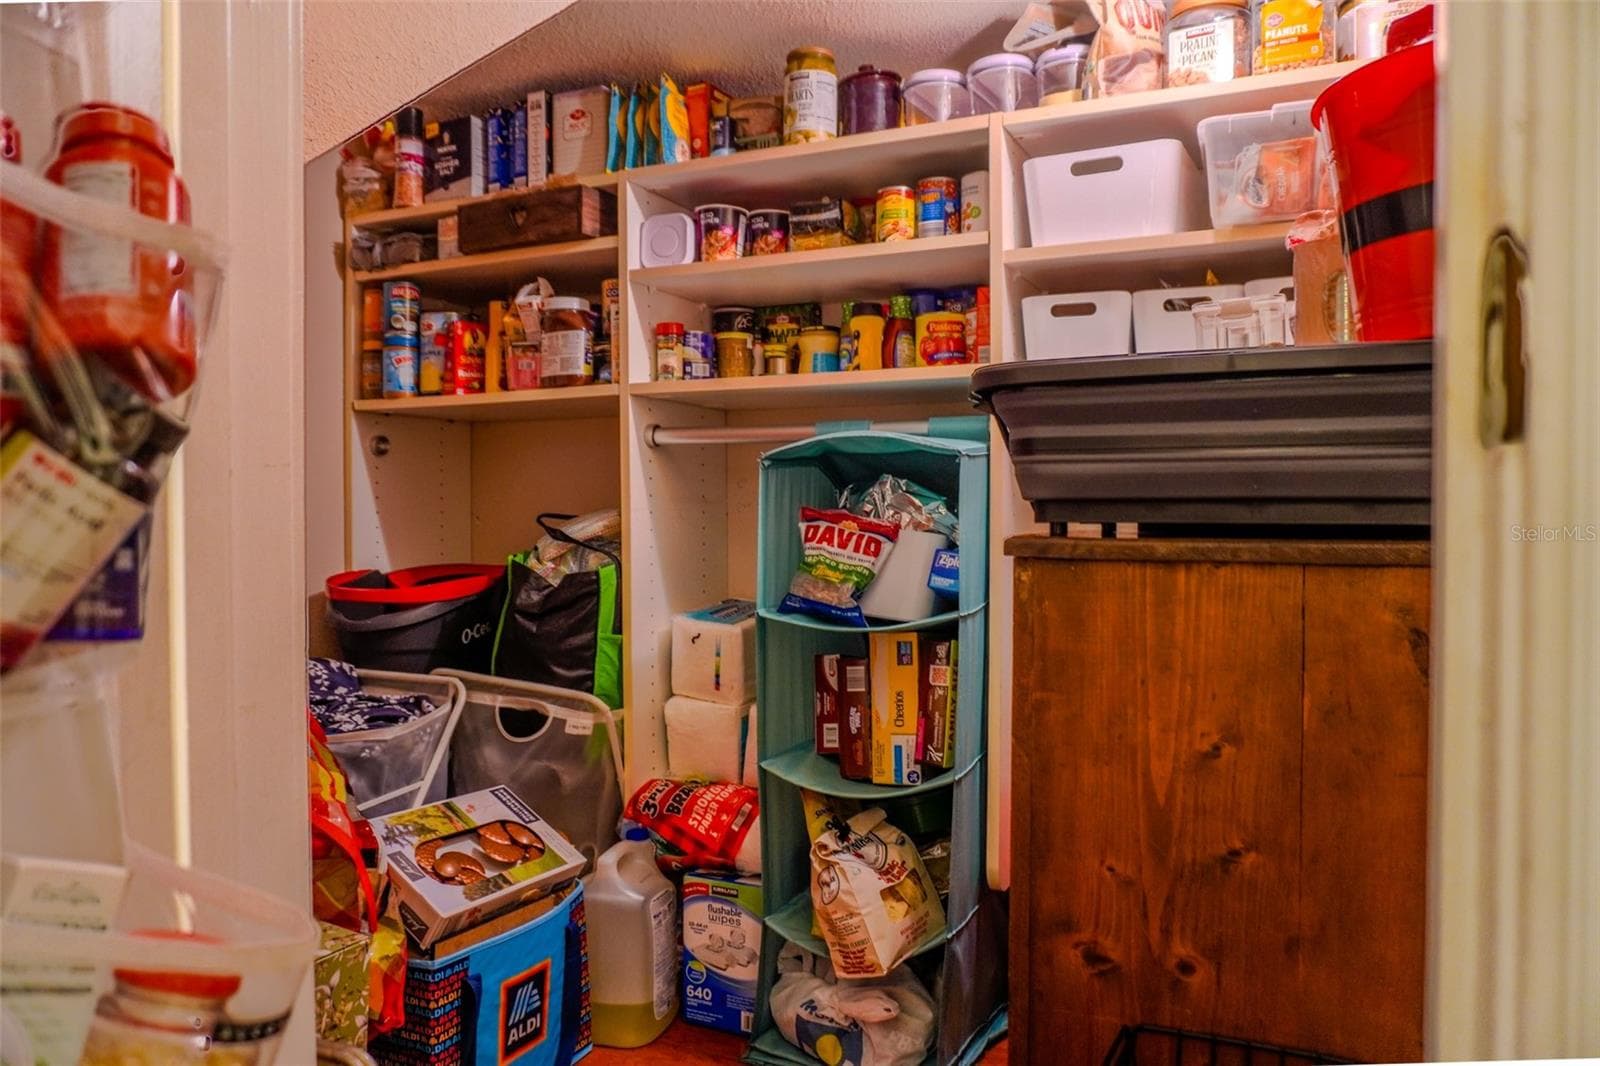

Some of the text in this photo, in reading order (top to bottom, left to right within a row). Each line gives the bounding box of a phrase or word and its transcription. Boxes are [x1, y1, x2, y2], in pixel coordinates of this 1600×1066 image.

[1265, 24, 1309, 40] PEANUTS
[1179, 34, 1219, 53] PRALIN
[1181, 49, 1219, 67] PECAN
[929, 323, 963, 333] Pastene
[804, 524, 882, 559] DAVID
[939, 553, 960, 569] Ziplo
[895, 690, 905, 728] Cheerios
[698, 801, 719, 835] PAPER
[708, 903, 743, 918] flushable
[708, 914, 742, 927] wipes
[686, 984, 712, 1001] 640
[507, 1012, 541, 1046] ALDI
